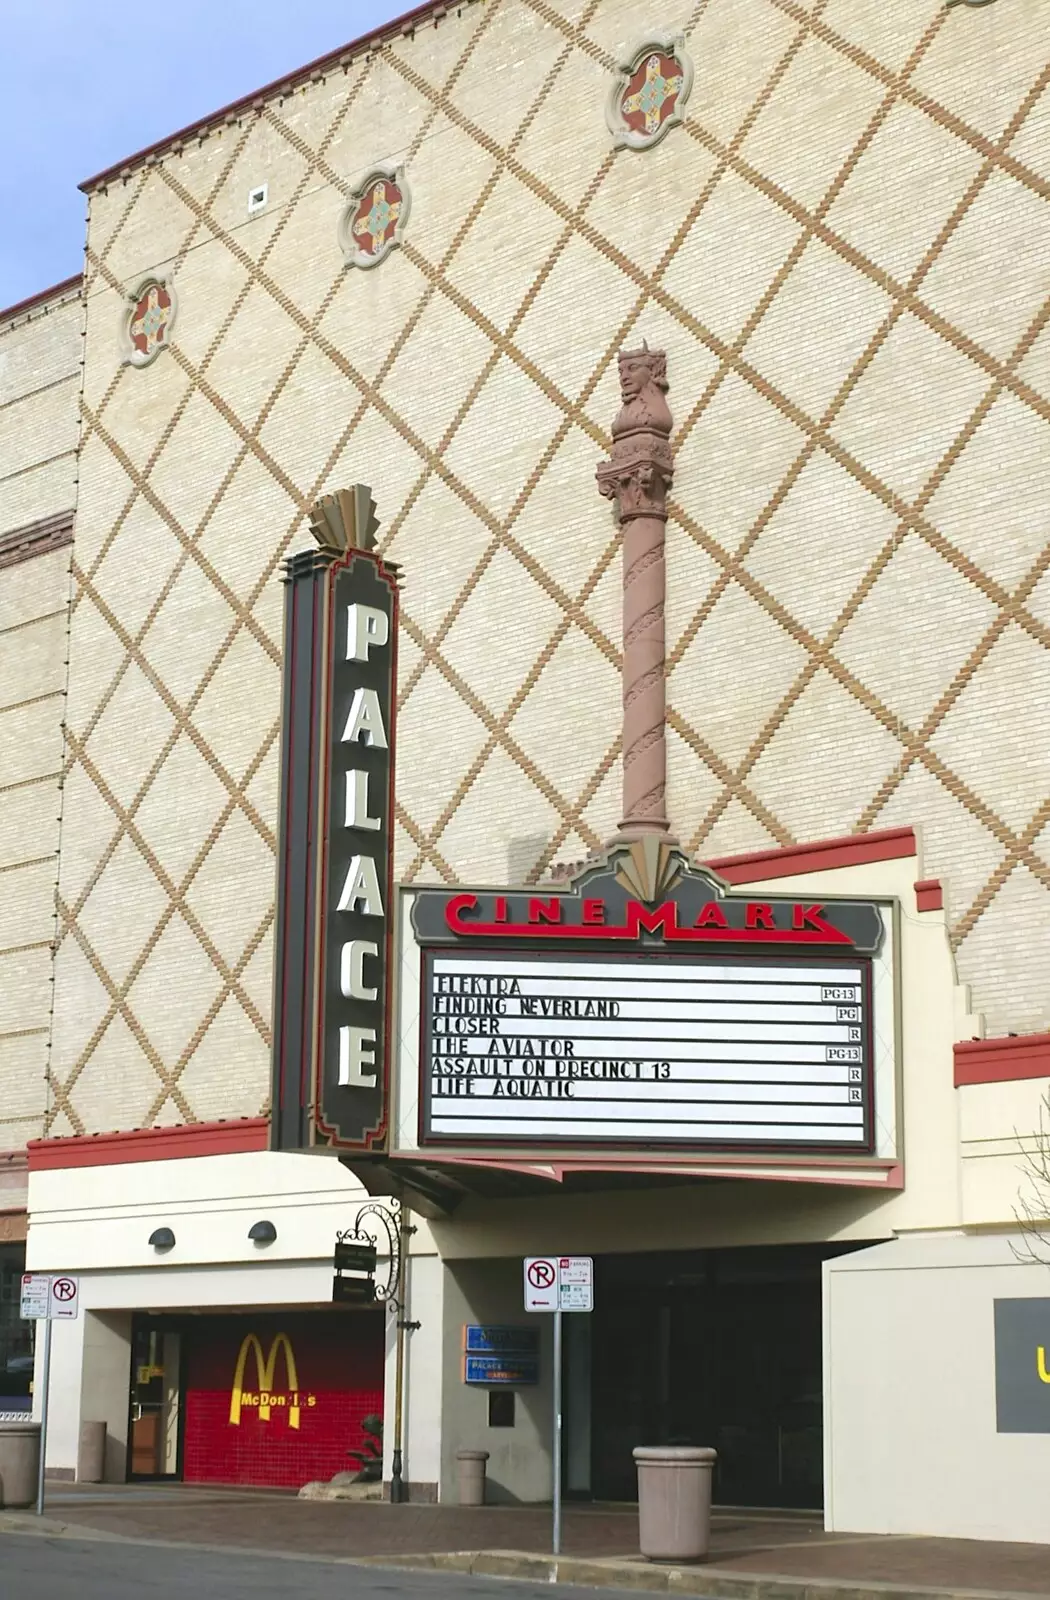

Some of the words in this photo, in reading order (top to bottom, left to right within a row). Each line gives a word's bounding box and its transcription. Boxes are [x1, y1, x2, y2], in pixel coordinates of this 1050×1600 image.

[340, 603, 389, 1088] PALACE
[445, 894, 857, 945] CINEMARK
[437, 977, 521, 996] ELEKTRA
[823, 988, 854, 999] PG-13
[434, 996, 507, 1015] FINDING
[520, 999, 621, 1017] NEVERLAND
[839, 1008, 856, 1019] PG
[432, 1016, 500, 1035] CLOSER
[851, 1029, 860, 1039] R
[432, 1037, 468, 1055] THE
[488, 1038, 575, 1057] AVIATOR
[828, 1048, 859, 1060] PG-13
[431, 1057, 514, 1076] ASSAULT
[522, 1059, 546, 1077] ON
[555, 1060, 644, 1079] PRECINCT
[651, 1062, 671, 1080] 13
[851, 1069, 860, 1079] R
[436, 1077, 475, 1096] LIFE
[492, 1079, 576, 1098] AQUATIC
[851, 1089, 860, 1100] R
